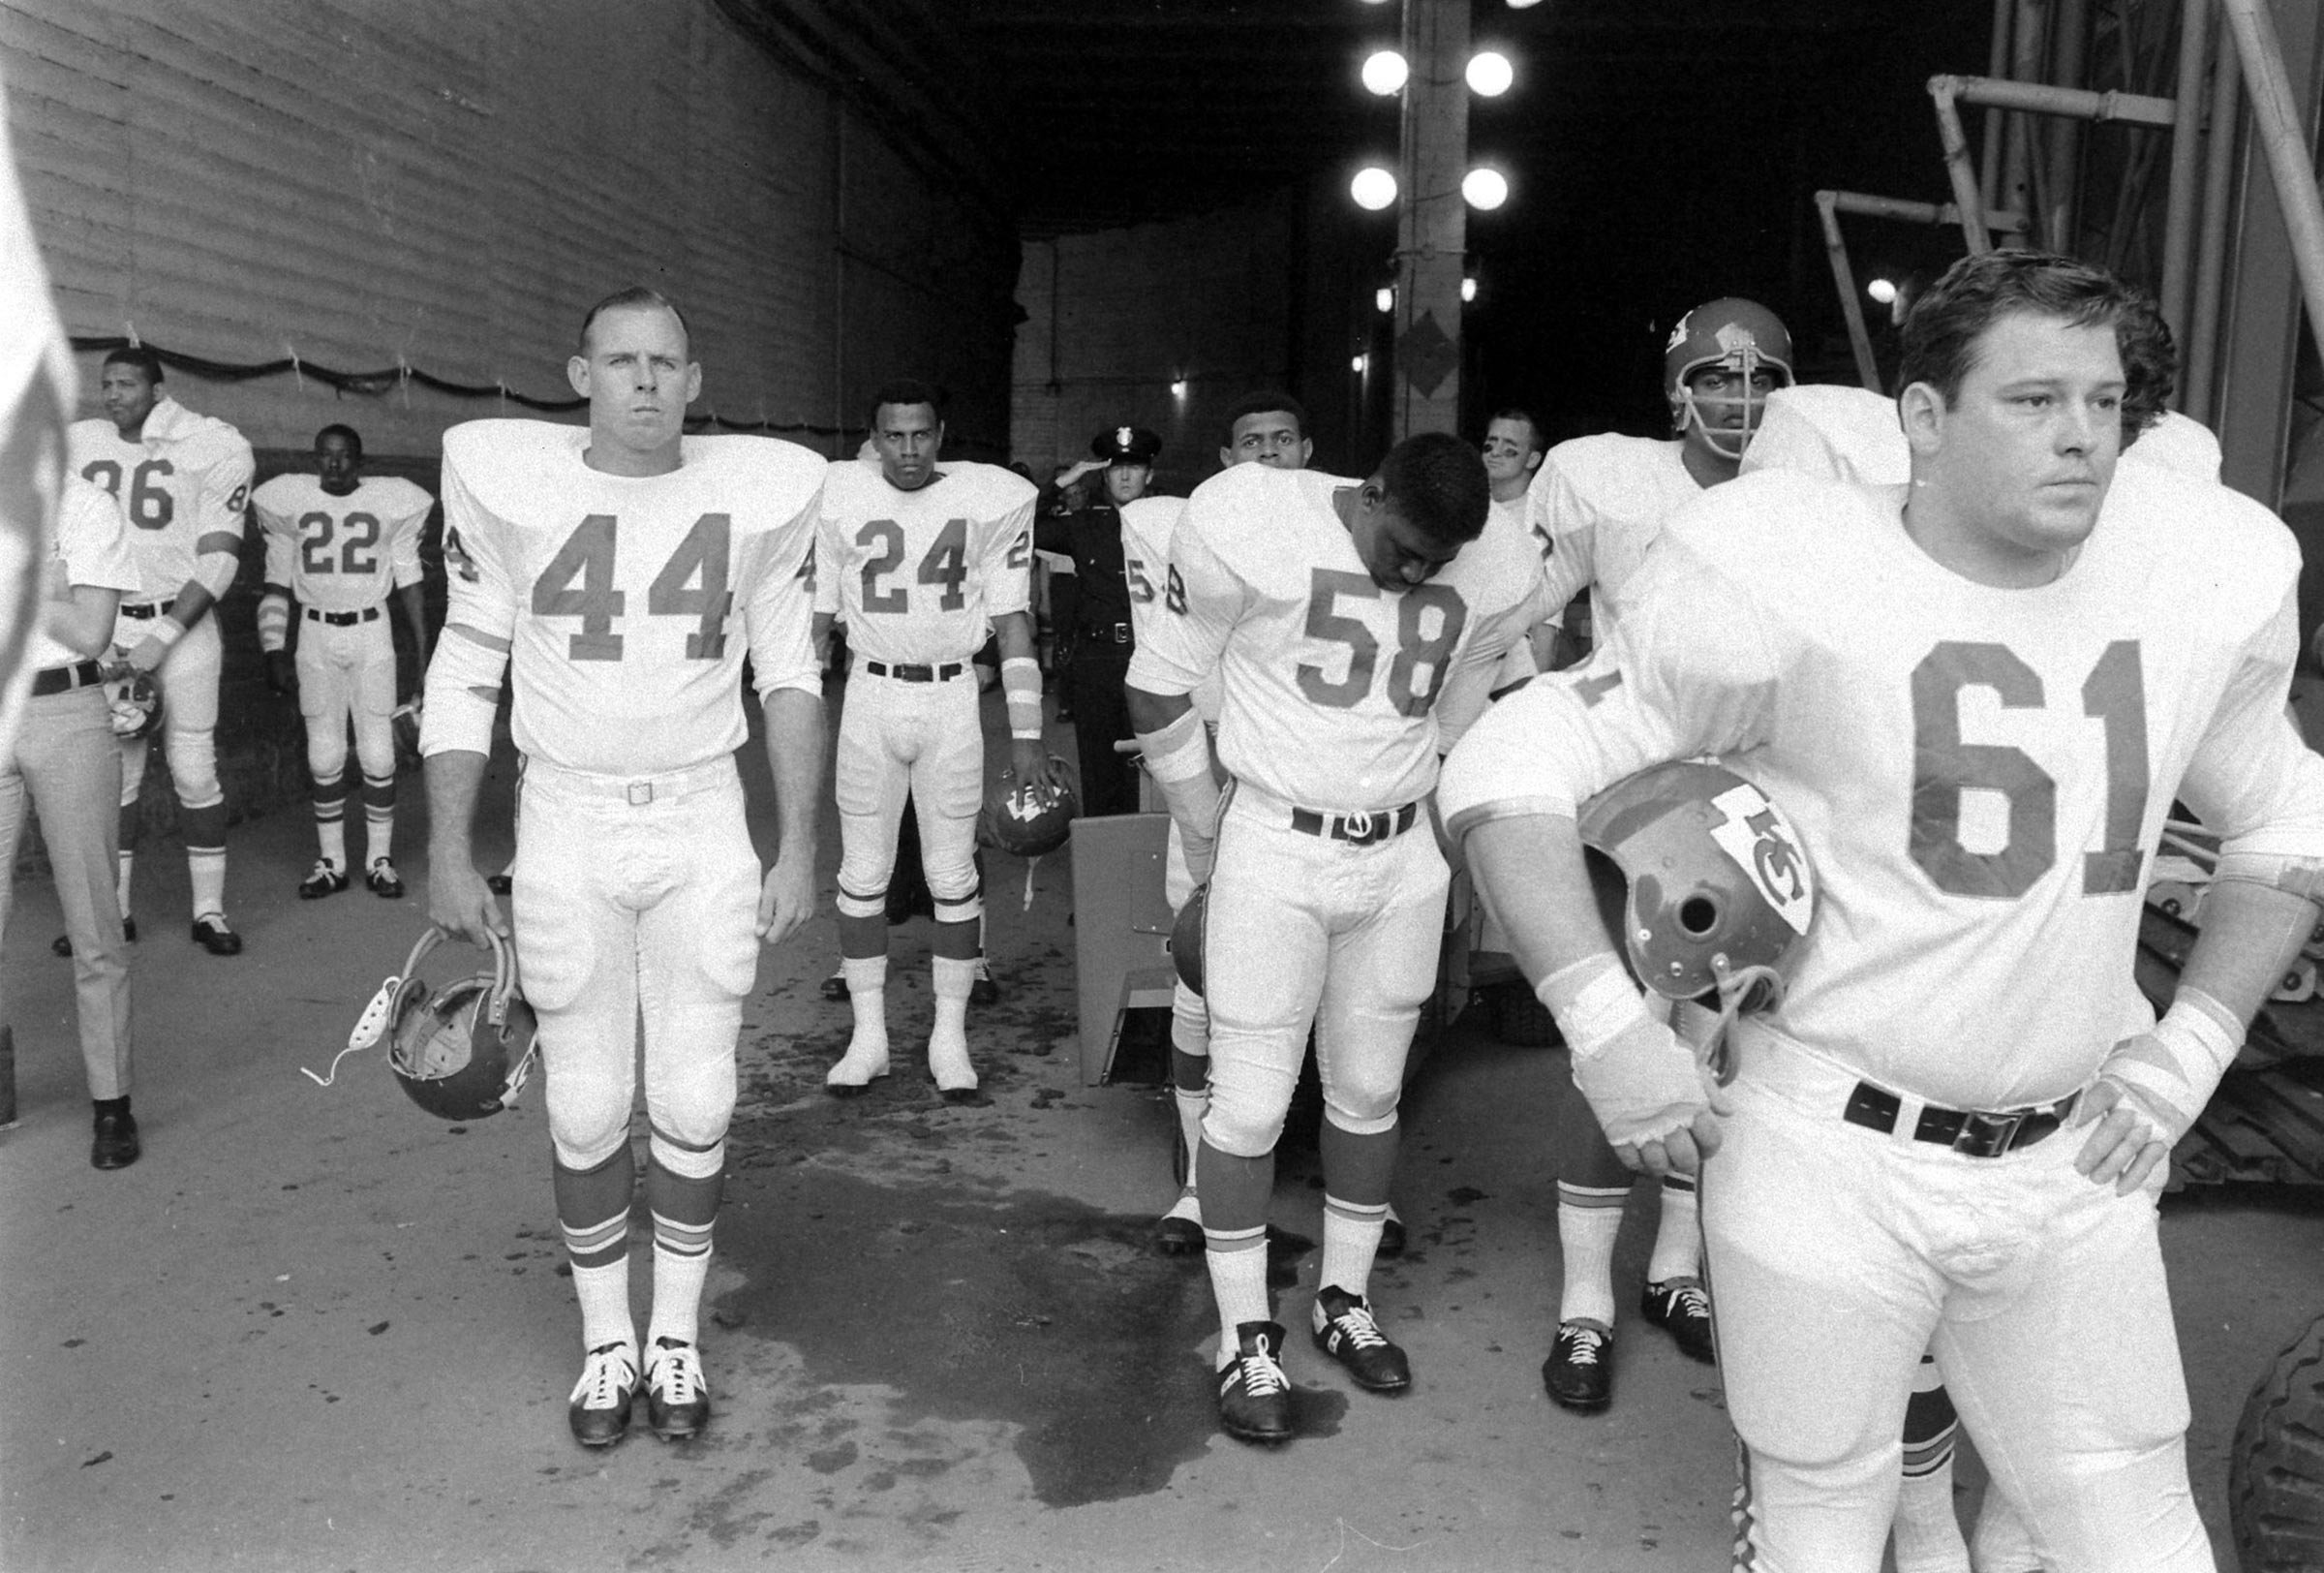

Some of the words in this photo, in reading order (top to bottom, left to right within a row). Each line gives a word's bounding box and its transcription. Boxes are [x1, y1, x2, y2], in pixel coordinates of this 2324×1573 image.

[298, 511, 381, 573] 22
[532, 512, 733, 662] 44
[855, 518, 968, 614] 24
[1007, 531, 1029, 570] 2
[1127, 559, 1166, 602] 5
[1296, 567, 1468, 718] 58
[1910, 639, 2151, 901] 61
